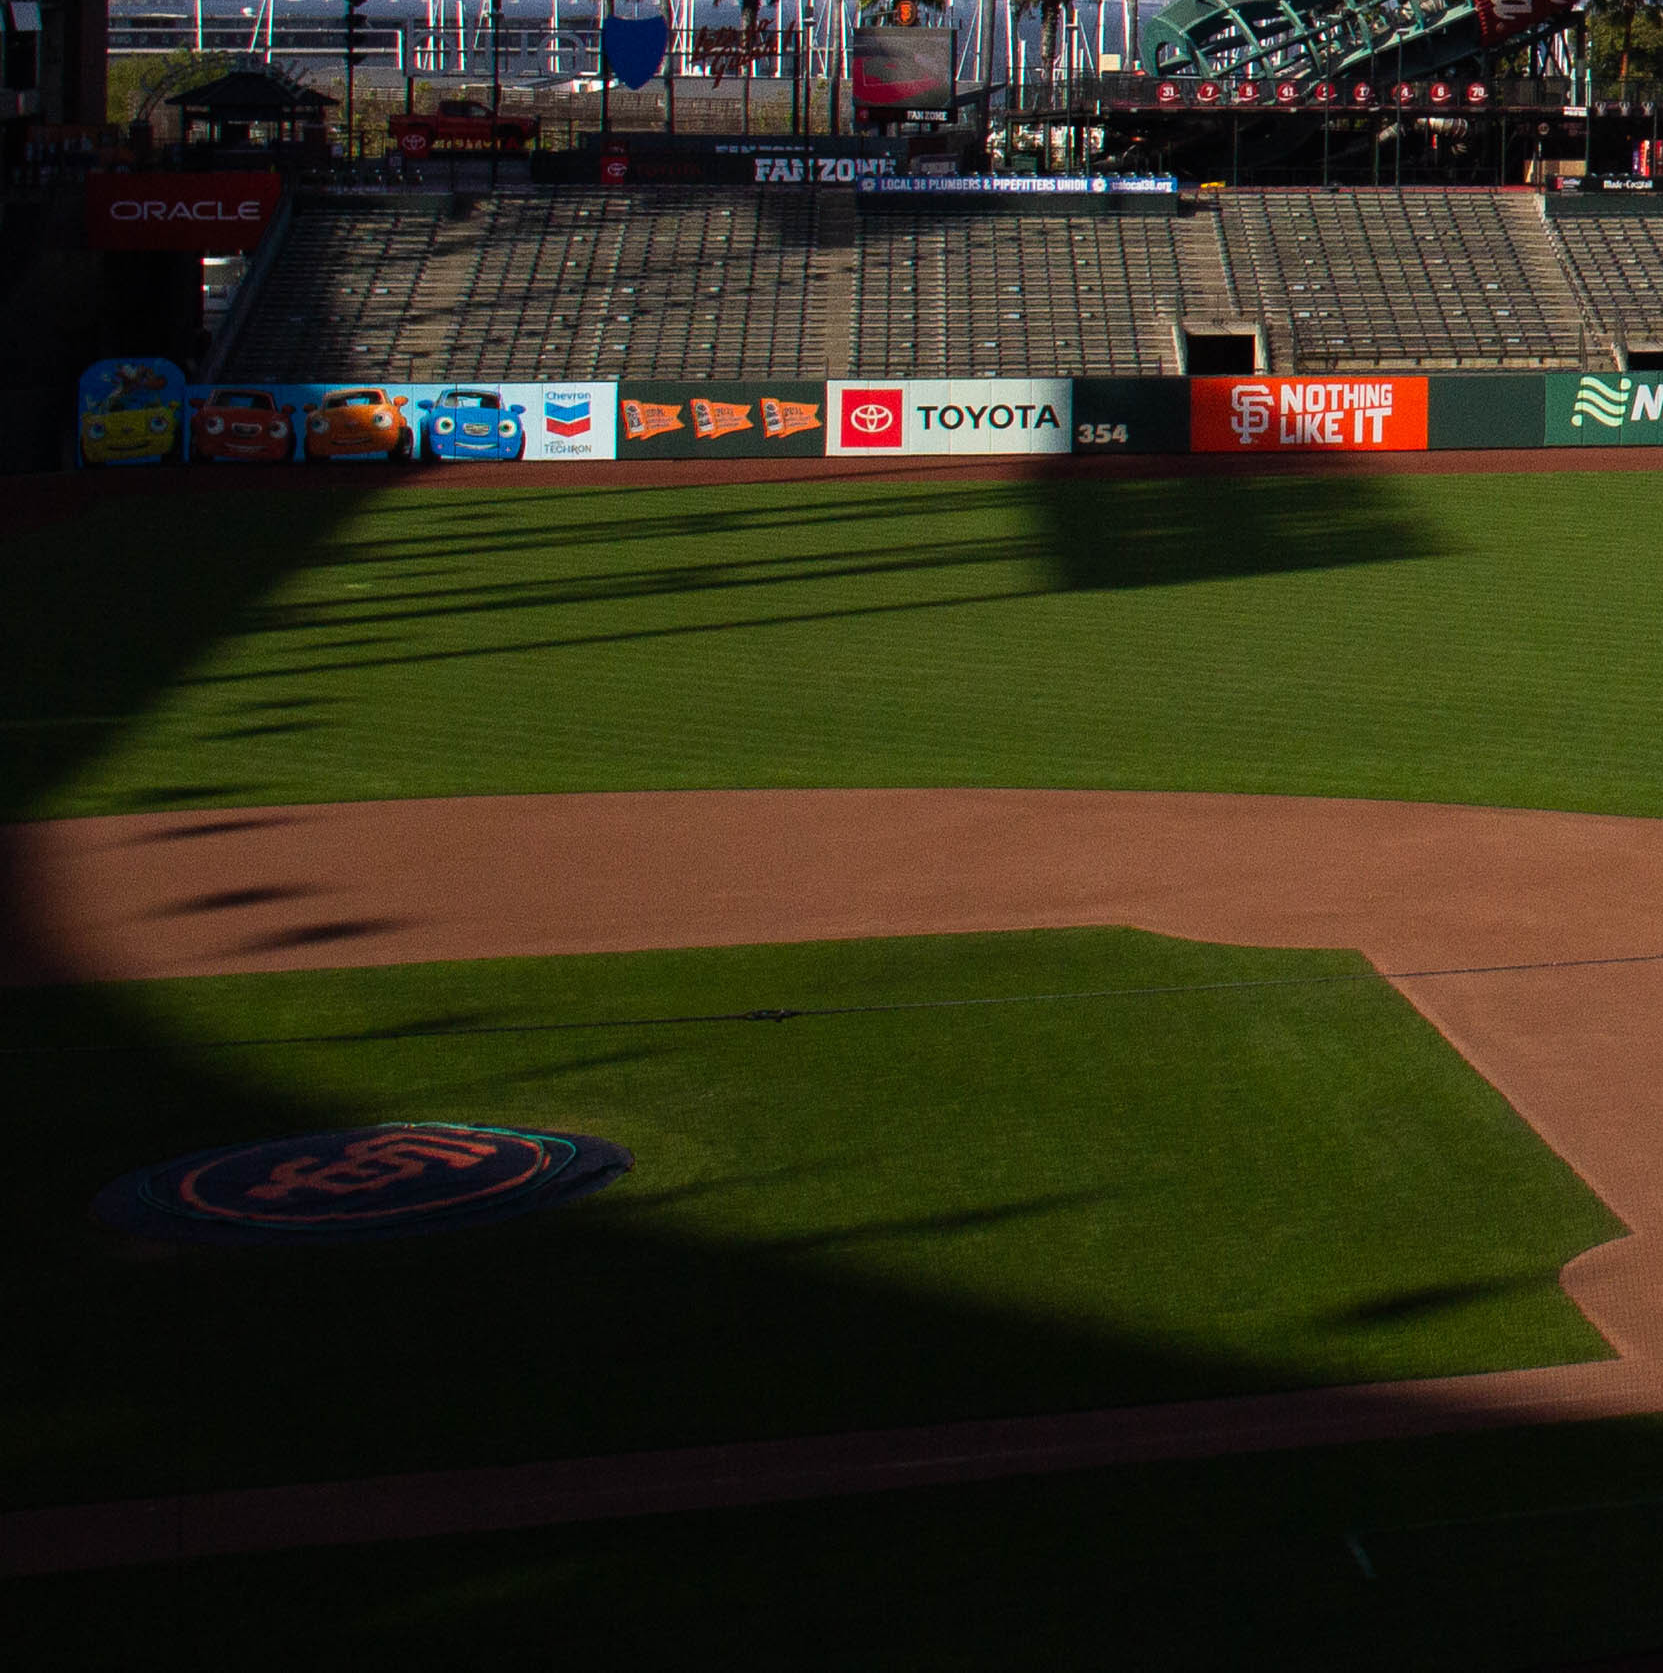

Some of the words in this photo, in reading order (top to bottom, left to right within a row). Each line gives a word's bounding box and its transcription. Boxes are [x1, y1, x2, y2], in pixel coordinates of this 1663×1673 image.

[1162, 87, 1174, 97] 31
[1205, 87, 1214, 97] 7
[907, 110, 924, 121] FAN
[925, 110, 949, 122] ZONE
[754, 157, 814, 182] FAN
[881, 178, 912, 191] LOCAL
[928, 178, 981, 191] PLUMBERS
[983, 178, 991, 191] &
[993, 178, 1056, 192] PIPEFITTERS
[1057, 179, 1088, 192] UNION
[110, 200, 261, 221] ORACLE
[545, 391, 591, 400] Chevron
[1280, 383, 1393, 408] NOTHING
[917, 403, 1061, 430] TOYOTA
[1077, 423, 1128, 444] 354
[1280, 412, 1343, 445] LIKE
[1353, 408, 1384, 444] IT
[544, 444, 592, 454] TECHRON
